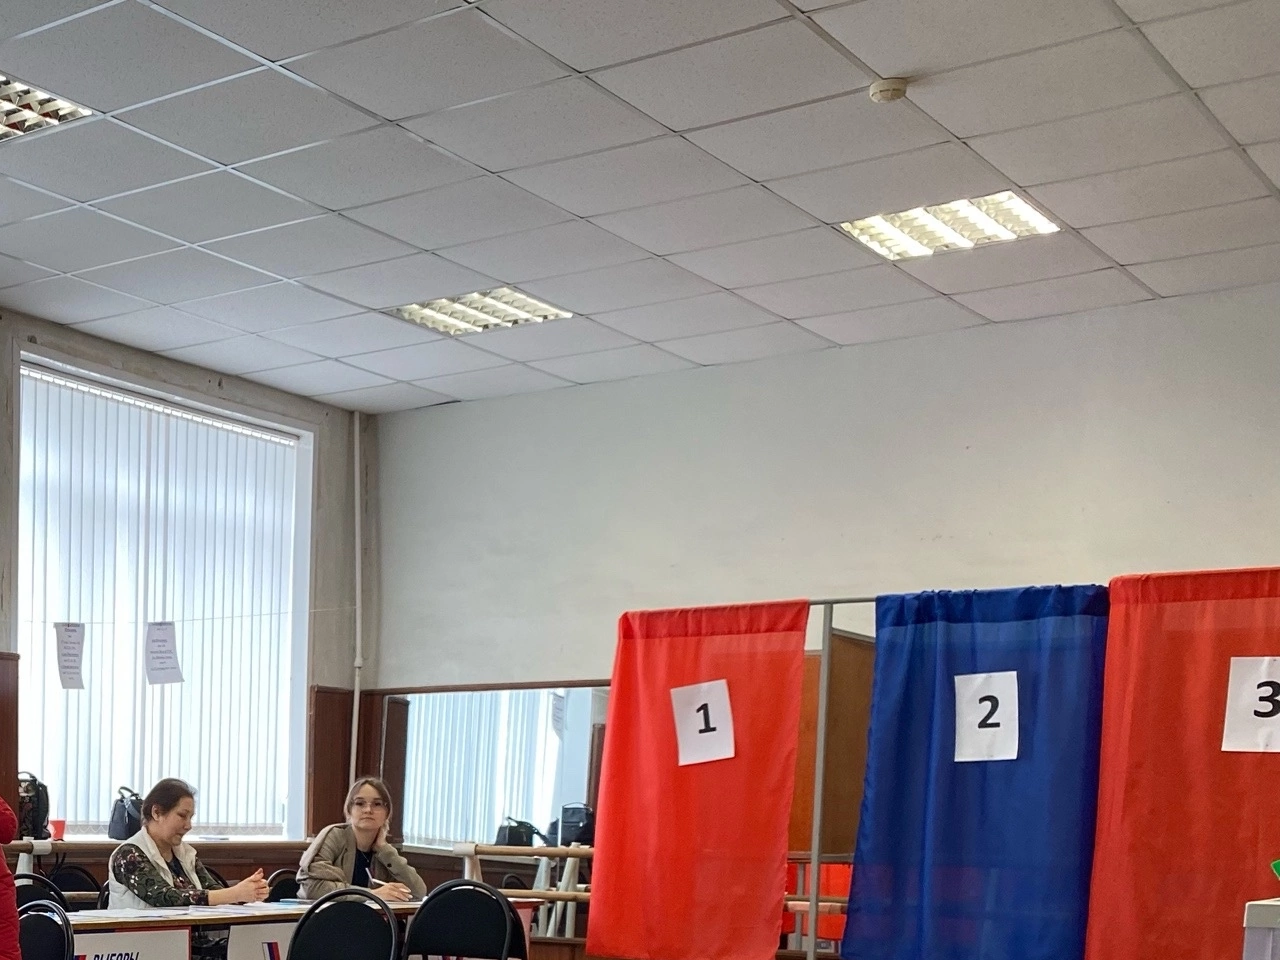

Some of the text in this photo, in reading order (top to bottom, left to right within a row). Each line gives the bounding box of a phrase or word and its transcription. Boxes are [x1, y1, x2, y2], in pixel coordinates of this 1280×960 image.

[977, 694, 1001, 729] 2
[1253, 680, 1280, 719] 3
[696, 702, 717, 734] 1
